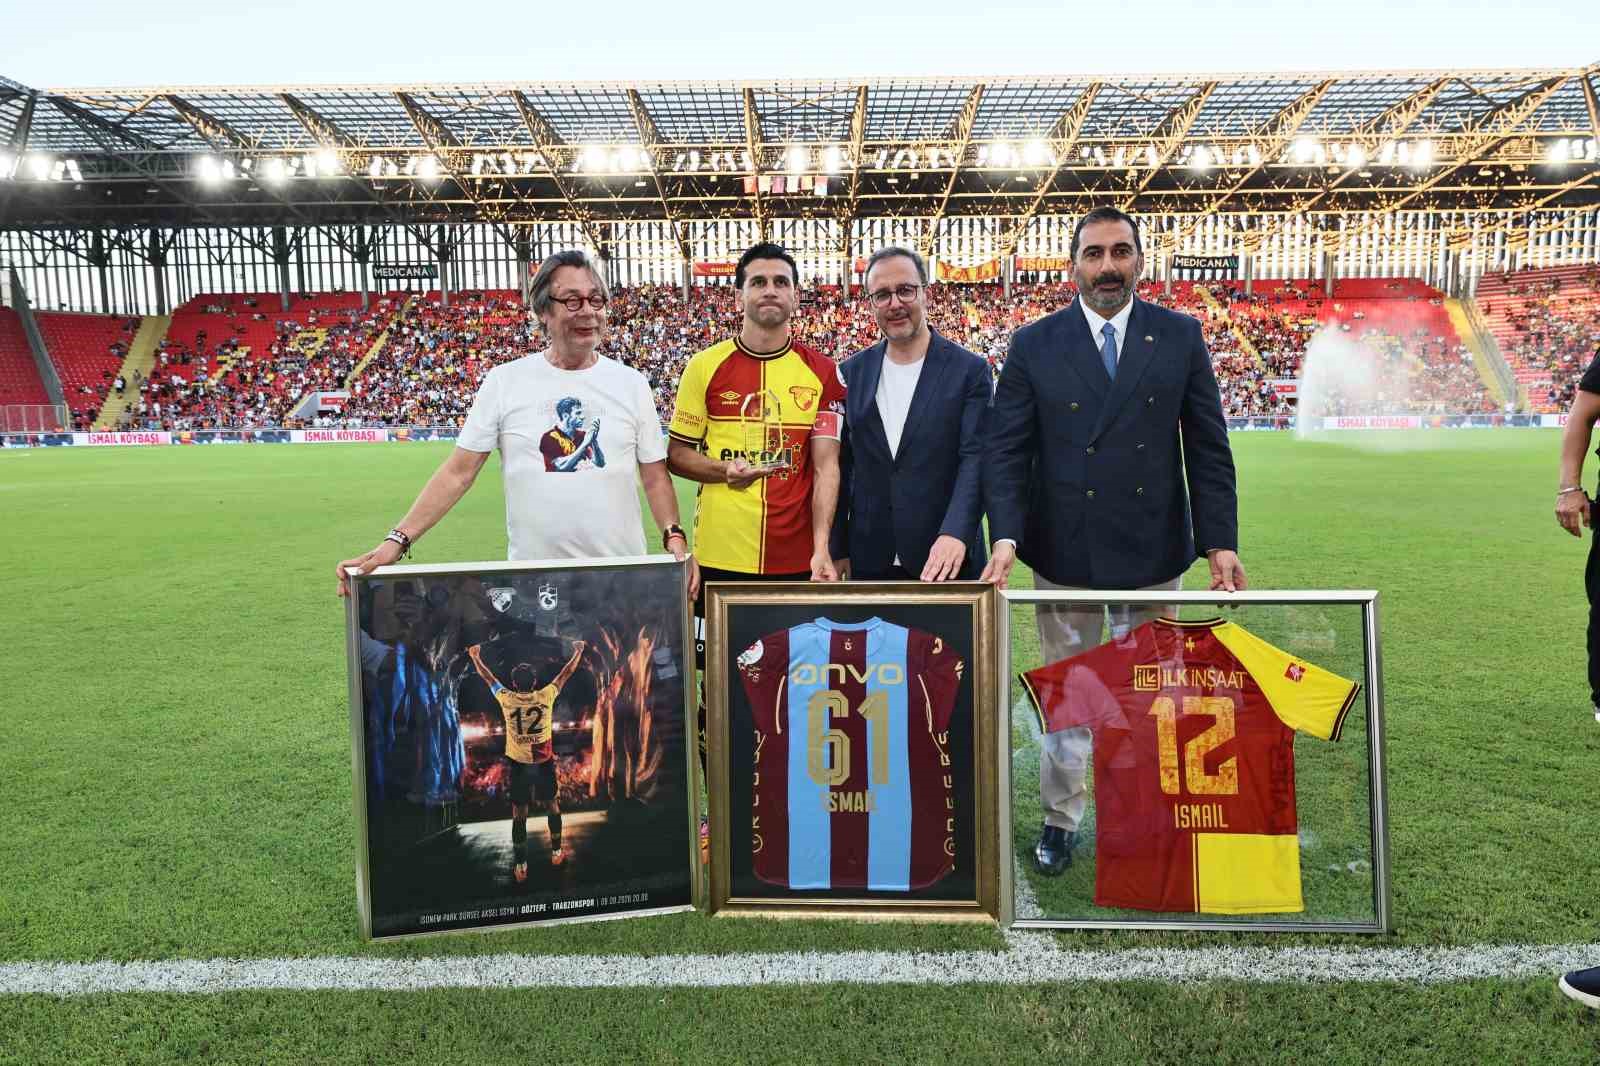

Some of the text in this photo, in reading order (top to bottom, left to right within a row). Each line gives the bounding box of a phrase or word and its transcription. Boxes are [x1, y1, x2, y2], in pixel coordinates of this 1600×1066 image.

[374, 267, 429, 277] MEDICANA
[1175, 256, 1229, 268] MEDICANA
[791, 663, 904, 685] onvo
[510, 706, 548, 735] 12
[807, 690, 889, 785] 61
[1148, 696, 1239, 795] 12
[521, 903, 546, 914] GÖZTEPE
[552, 898, 595, 911] TRABZONSPOR
